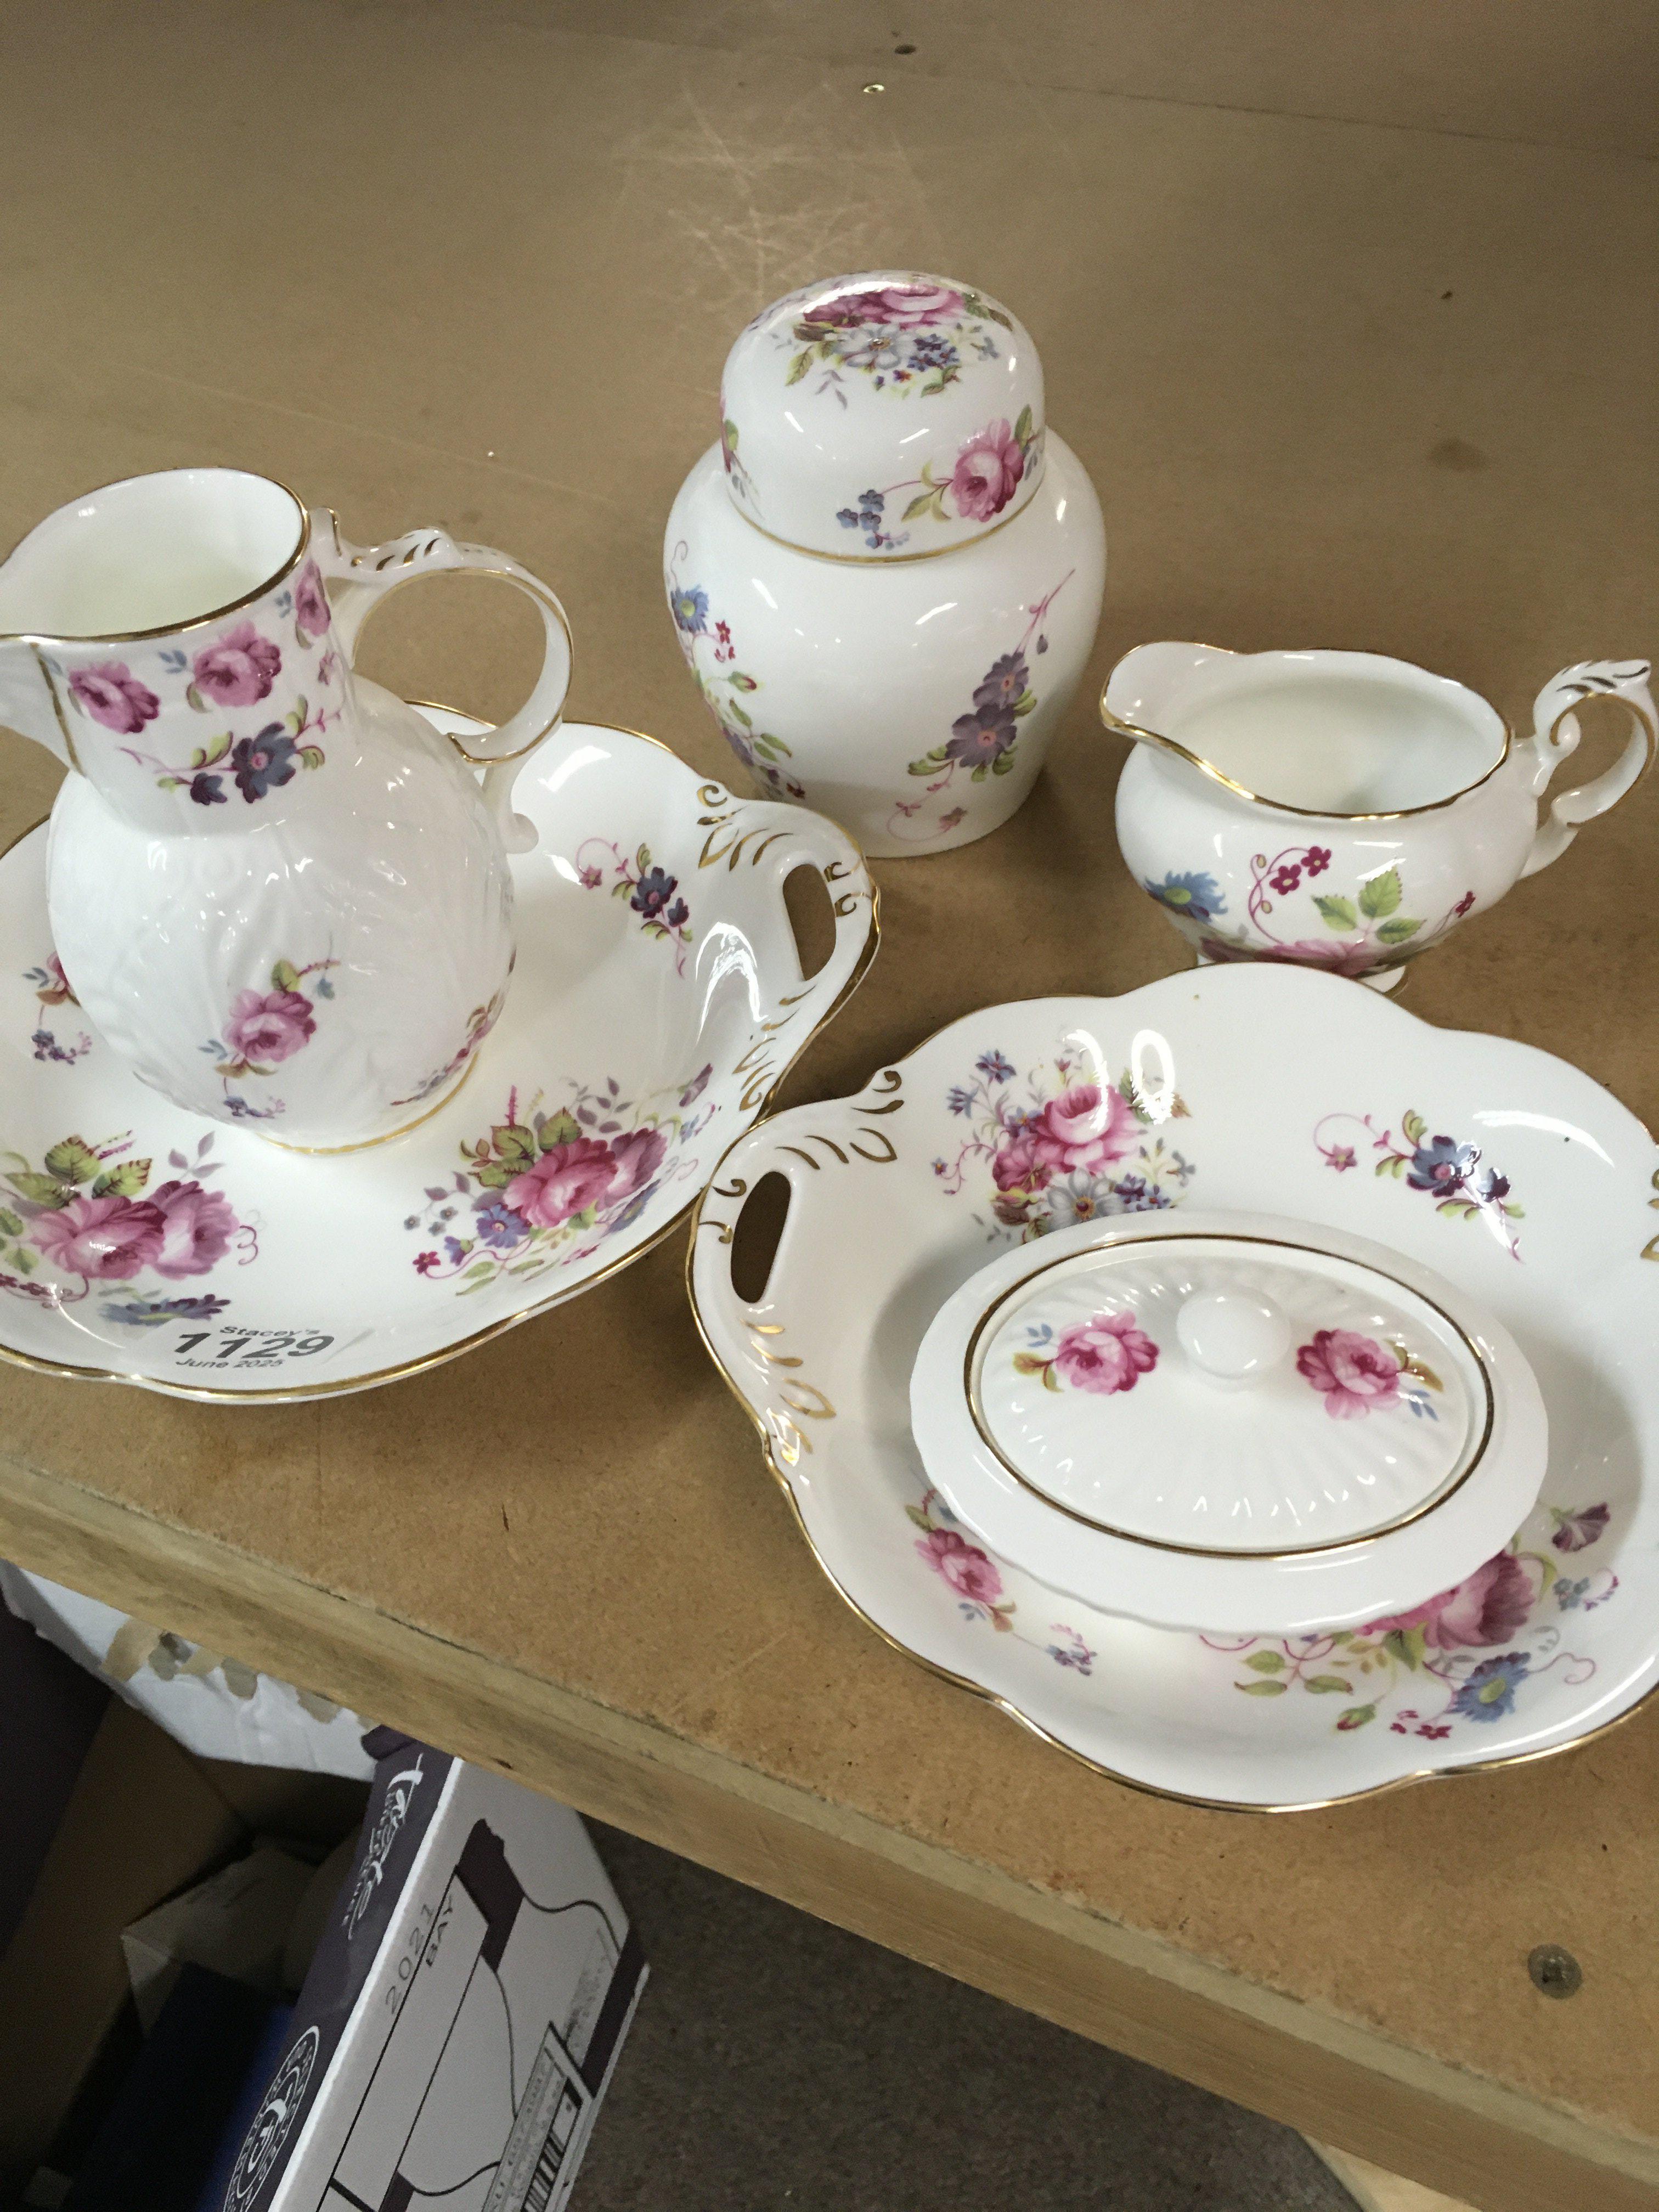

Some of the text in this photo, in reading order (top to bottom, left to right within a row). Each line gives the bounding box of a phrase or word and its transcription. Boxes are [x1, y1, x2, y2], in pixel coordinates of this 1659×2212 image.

[220, 1326, 320, 1337] Stacey's
[174, 1333, 334, 1358] 1129
[176, 1358, 229, 1368] June
